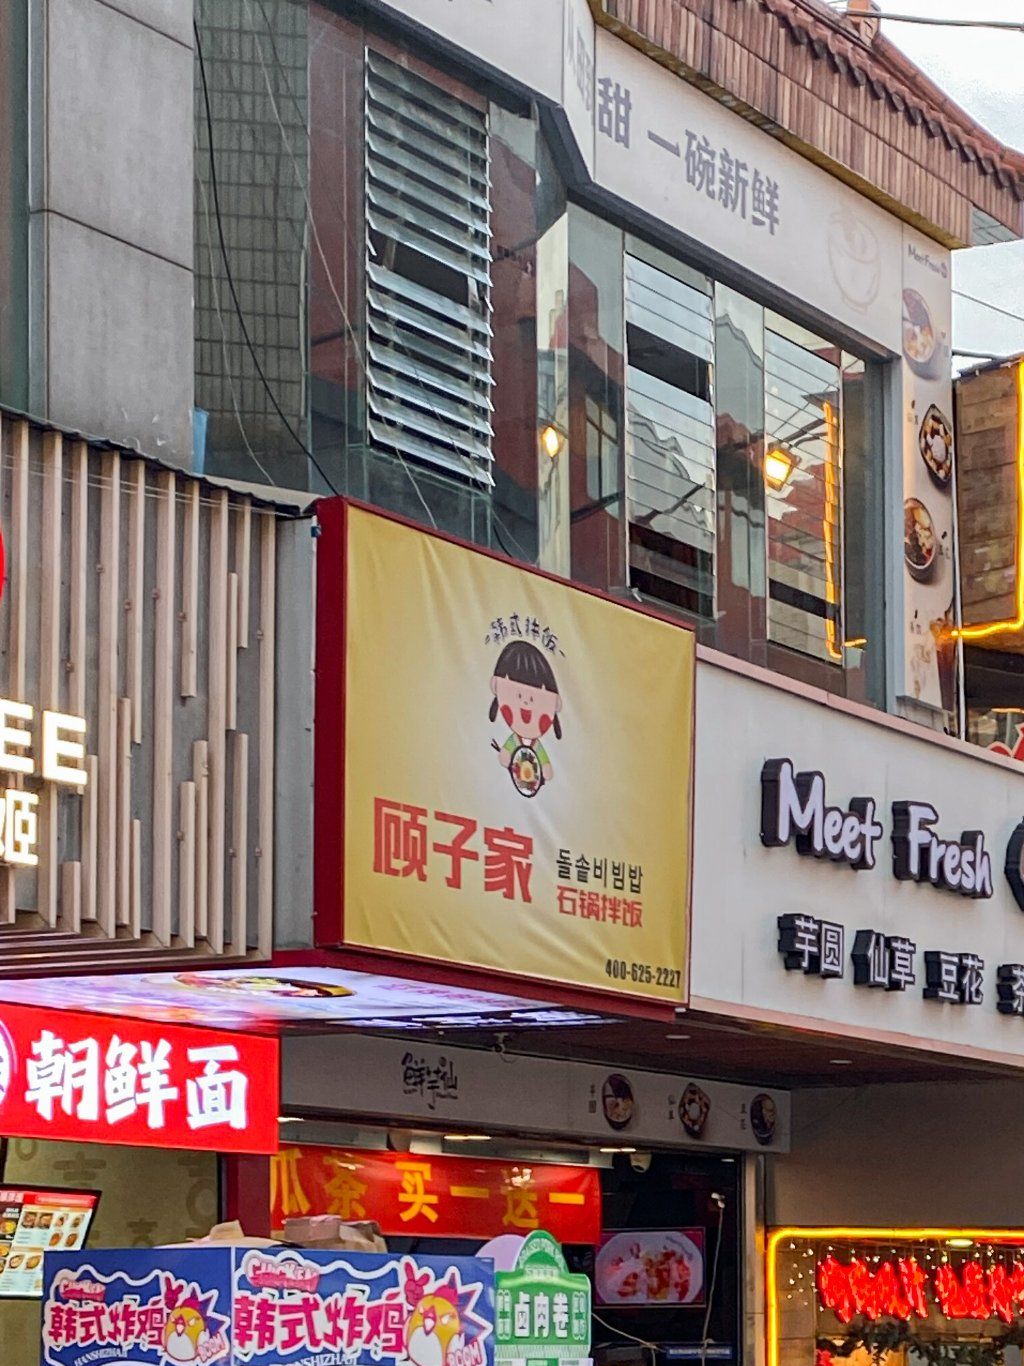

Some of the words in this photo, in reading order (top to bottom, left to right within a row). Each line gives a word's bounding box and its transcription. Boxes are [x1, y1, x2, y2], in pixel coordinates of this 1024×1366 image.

[598, 77, 632, 149] 甜
[647, 129, 780, 235] 一碗新鲜
[373, 797, 534, 903] 顾子家
[555, 848, 644, 894] 돌솥비빔밥
[762, 758, 883, 870] Meet
[893, 800, 993, 899] Fresh
[556, 885, 644, 929] 石锅拌饭
[781, 914, 845, 979] 芋圆
[854, 931, 916, 991] 仙草
[925, 952, 984, 1005] 豆花
[25, 1030, 248, 1130] 朝鲜面
[49, 1303, 164, 1346] 韩式炸鸡
[234, 1292, 404, 1353] 韩式炸鸡
